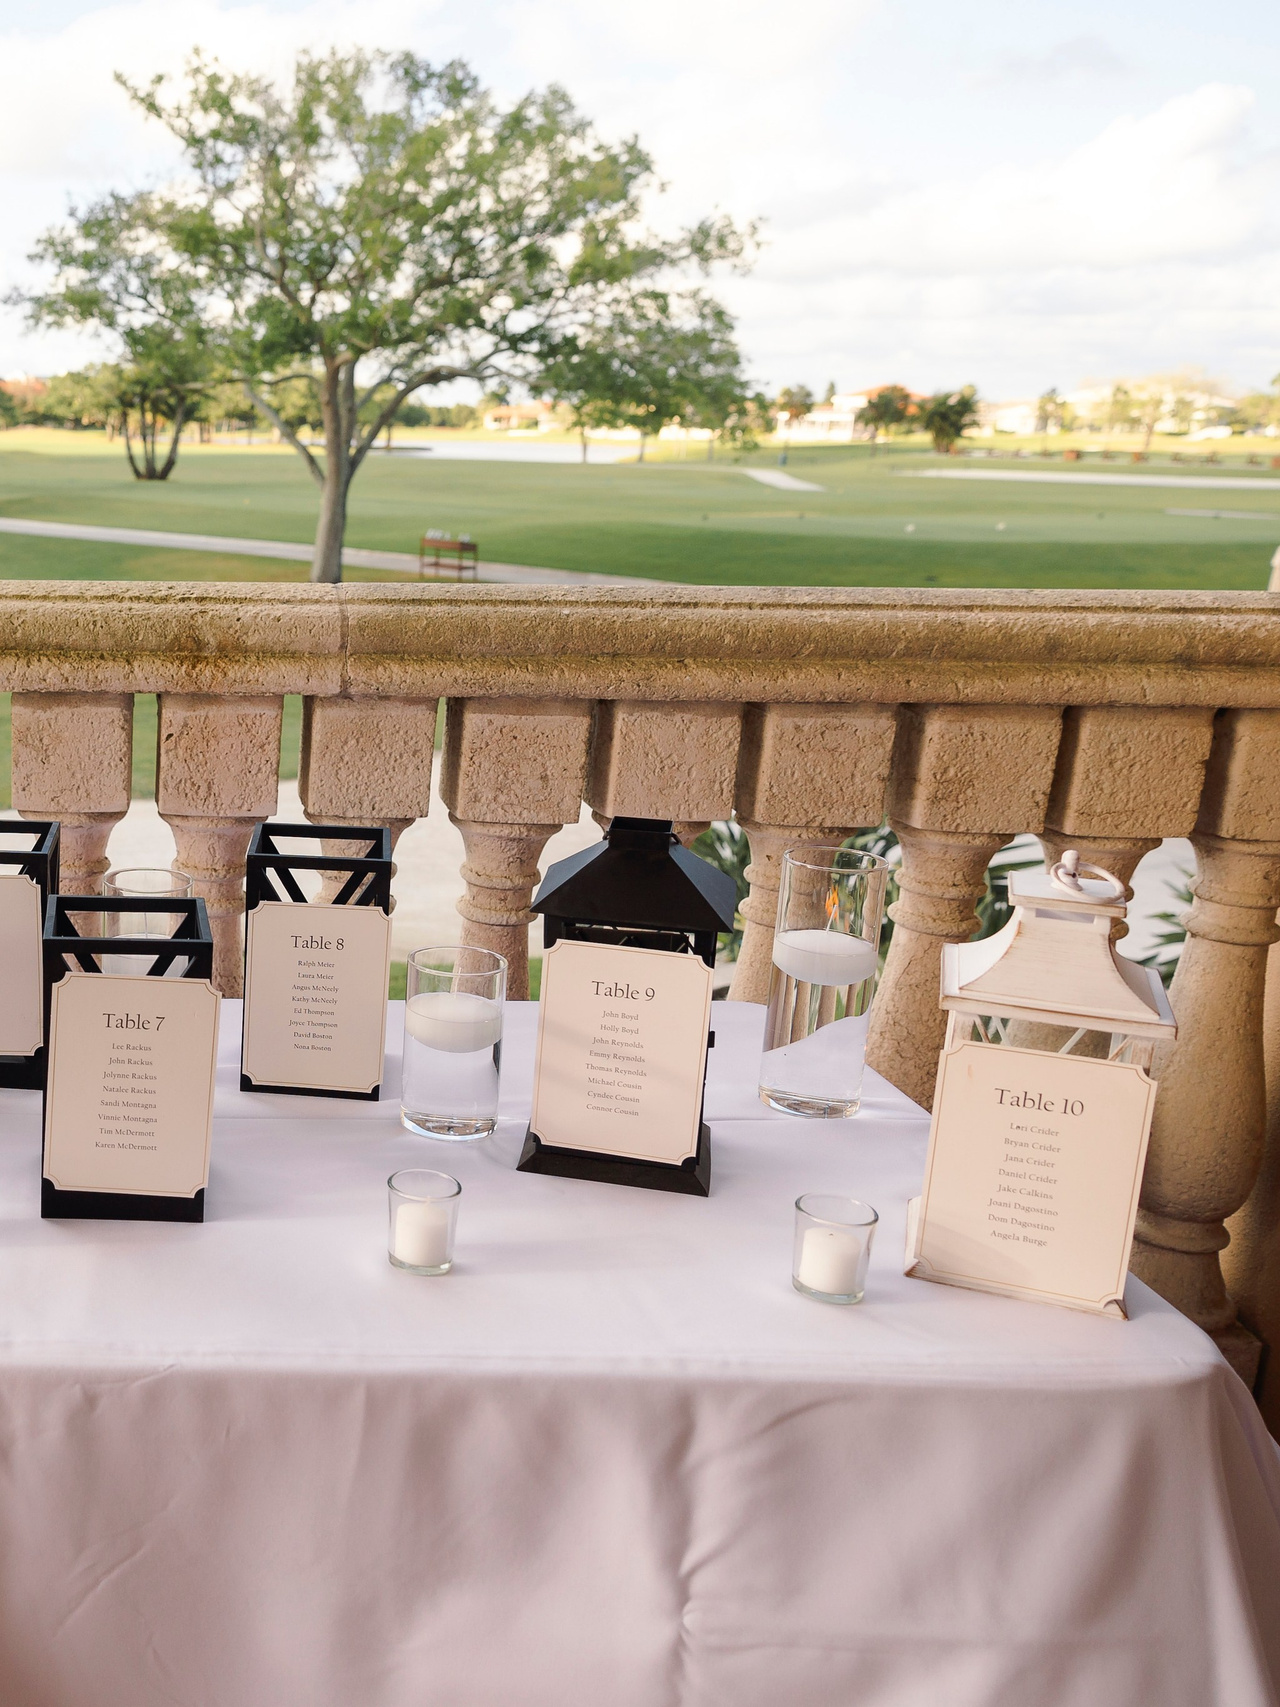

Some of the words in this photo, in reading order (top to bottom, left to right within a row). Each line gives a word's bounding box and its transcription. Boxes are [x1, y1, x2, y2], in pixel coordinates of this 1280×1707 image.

[290, 935, 332, 950] Table
[335, 938, 345, 951] 8
[298, 960, 316, 968] Ralph
[291, 984, 311, 992] Angus
[311, 985, 339, 994] McNeely
[591, 980, 640, 1000] Table
[644, 987, 656, 1002] 9
[292, 996, 310, 1004] Kathy
[310, 996, 338, 1005] McNeely
[303, 1008, 335, 1017] Thompson
[601, 1010, 619, 1018] John
[621, 1012, 639, 1022] Boyd
[102, 1012, 151, 1031] Table
[155, 1016, 166, 1031] 7
[288, 1019, 306, 1027] Joyce
[306, 1020, 338, 1029] Thompson
[293, 1031, 311, 1039] David
[312, 1032, 333, 1040] Boston
[600, 1024, 620, 1034] Holly
[621, 1026, 639, 1036] Boyd
[126, 1043, 152, 1051] Rackus
[311, 1044, 332, 1052] Boston
[592, 1037, 610, 1045] John
[611, 1039, 644, 1049] Reynolds
[108, 1057, 126, 1066] John
[127, 1058, 153, 1066] Rackus
[589, 1050, 612, 1060] Emmy
[612, 1053, 646, 1063] Reynolds
[102, 1071, 130, 1080] Jolynne
[585, 1063, 613, 1072] Thomas
[614, 1067, 647, 1077] Reynolds
[102, 1085, 129, 1093] Natalee
[588, 1077, 616, 1086] Michael
[617, 1081, 642, 1090] Cousin
[587, 1090, 614, 1100] Cyndee
[614, 1094, 640, 1103] Cousin
[994, 1087, 1055, 1112] Table
[1060, 1098, 1085, 1117] 10
[121, 1100, 157, 1110] Montagna
[586, 1103, 613, 1112] Connor
[614, 1107, 639, 1116] Cousin
[98, 1113, 121, 1121] Vinnie
[122, 1115, 158, 1124] Montagna
[115, 1128, 155, 1137] McDermott
[1030, 1126, 1060, 1137] Crider
[95, 1141, 116, 1149] Karen
[117, 1142, 157, 1151] McDermott
[1004, 1137, 1029, 1148] Bryan
[1031, 1142, 1061, 1153] Crider
[1003, 1153, 1024, 1163] Jana
[1026, 1157, 1055, 1168] Crider
[998, 1168, 1027, 1179] Daniel
[1028, 1173, 1058, 1185] Crider
[996, 1184, 1017, 1194] Jake
[1019, 1188, 1053, 1200] Calkins
[987, 1198, 1011, 1208] Joani
[1014, 1202, 1058, 1216] Dagostino
[988, 1213, 1008, 1223] Dom
[1010, 1217, 1055, 1231] Dagostino
[990, 1230, 1020, 1241] Angela
[1022, 1235, 1047, 1247] Burge
